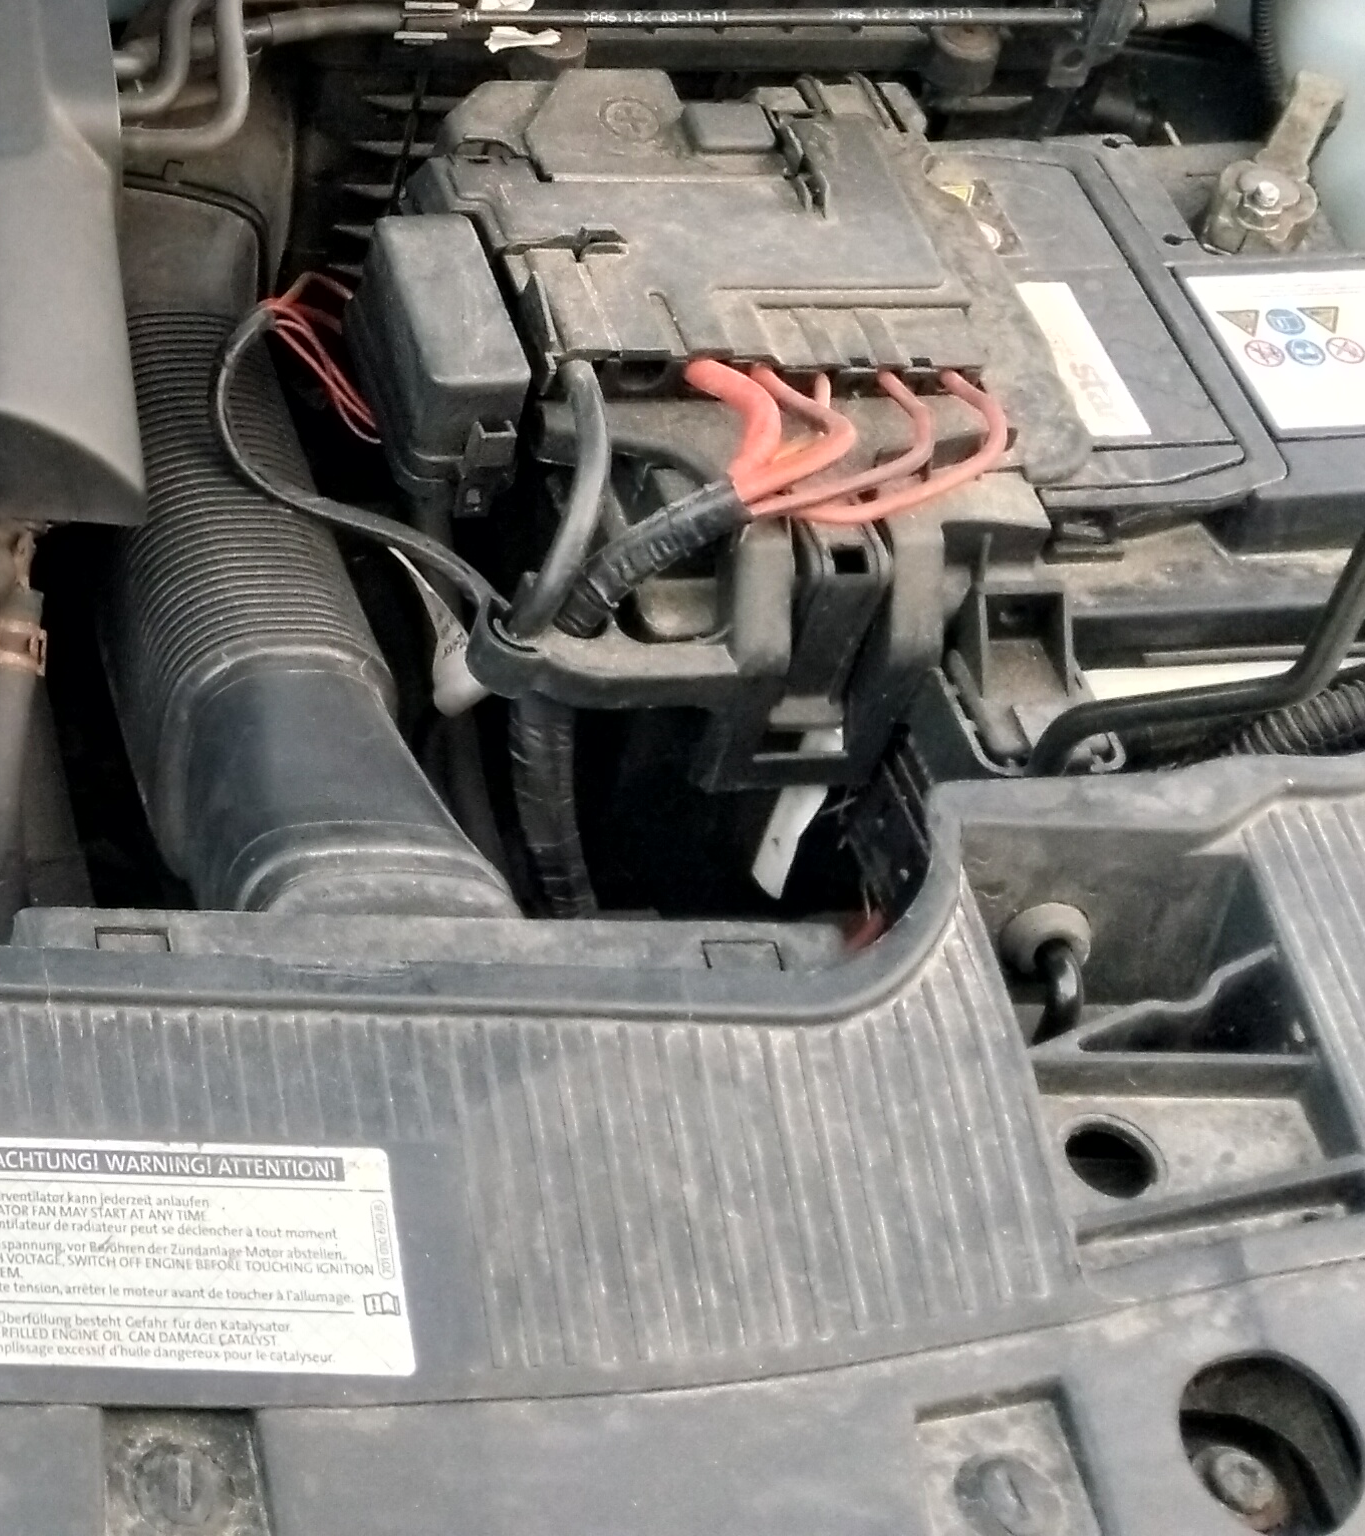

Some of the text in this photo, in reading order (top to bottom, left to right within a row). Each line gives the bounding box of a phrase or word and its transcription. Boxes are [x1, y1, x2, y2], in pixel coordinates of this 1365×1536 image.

[105, 1153, 212, 1175] WARNING!
[218, 1157, 336, 1179] ATTENTION!
[68, 1191, 98, 1205] kann
[100, 1193, 152, 1208] jederzeit
[32, 1205, 57, 1217] FAN
[59, 1206, 88, 1218] MAY
[90, 1207, 127, 1219] START
[130, 1208, 146, 1219] AT
[148, 1209, 174, 1221] ANY
[53, 1218, 69, 1231] de
[71, 1220, 127, 1233] radiateur
[130, 1222, 159, 1236] peut
[161, 1225, 175, 1235] se
[256, 1226, 283, 1239] tout
[68, 1243, 87, 1253] vor
[147, 1243, 168, 1256] der
[245, 1245, 284, 1259] Motor
[68, 1254, 116, 1268] SWITCH
[119, 1256, 142, 1268] OFF
[145, 1257, 193, 1270] ENGINE
[196, 1258, 242, 1271] BEFORE
[245, 1260, 314, 1273] TOUCHING
[317, 1261, 375, 1276] IGNITION
[109, 1283, 120, 1297] le
[122, 1285, 168, 1298] moteur
[171, 1287, 205, 1300] avant
[208, 1288, 224, 1300] de
[226, 1288, 274, 1302] toucher
[75, 1313, 121, 1328] besteht
[125, 1315, 168, 1330] Gefahr
[194, 1317, 217, 1331] den
[52, 1328, 99, 1342] ENGINE
[102, 1329, 123, 1342] OIL
[128, 1330, 156, 1343] CAN
[159, 1331, 216, 1345] DAMAGE
[57, 1343, 105, 1357] excessif
[109, 1343, 152, 1358] d'huile
[153, 1345, 221, 1362] dangereux
[223, 1350, 253, 1363] pour
[256, 1349, 268, 1362] le
